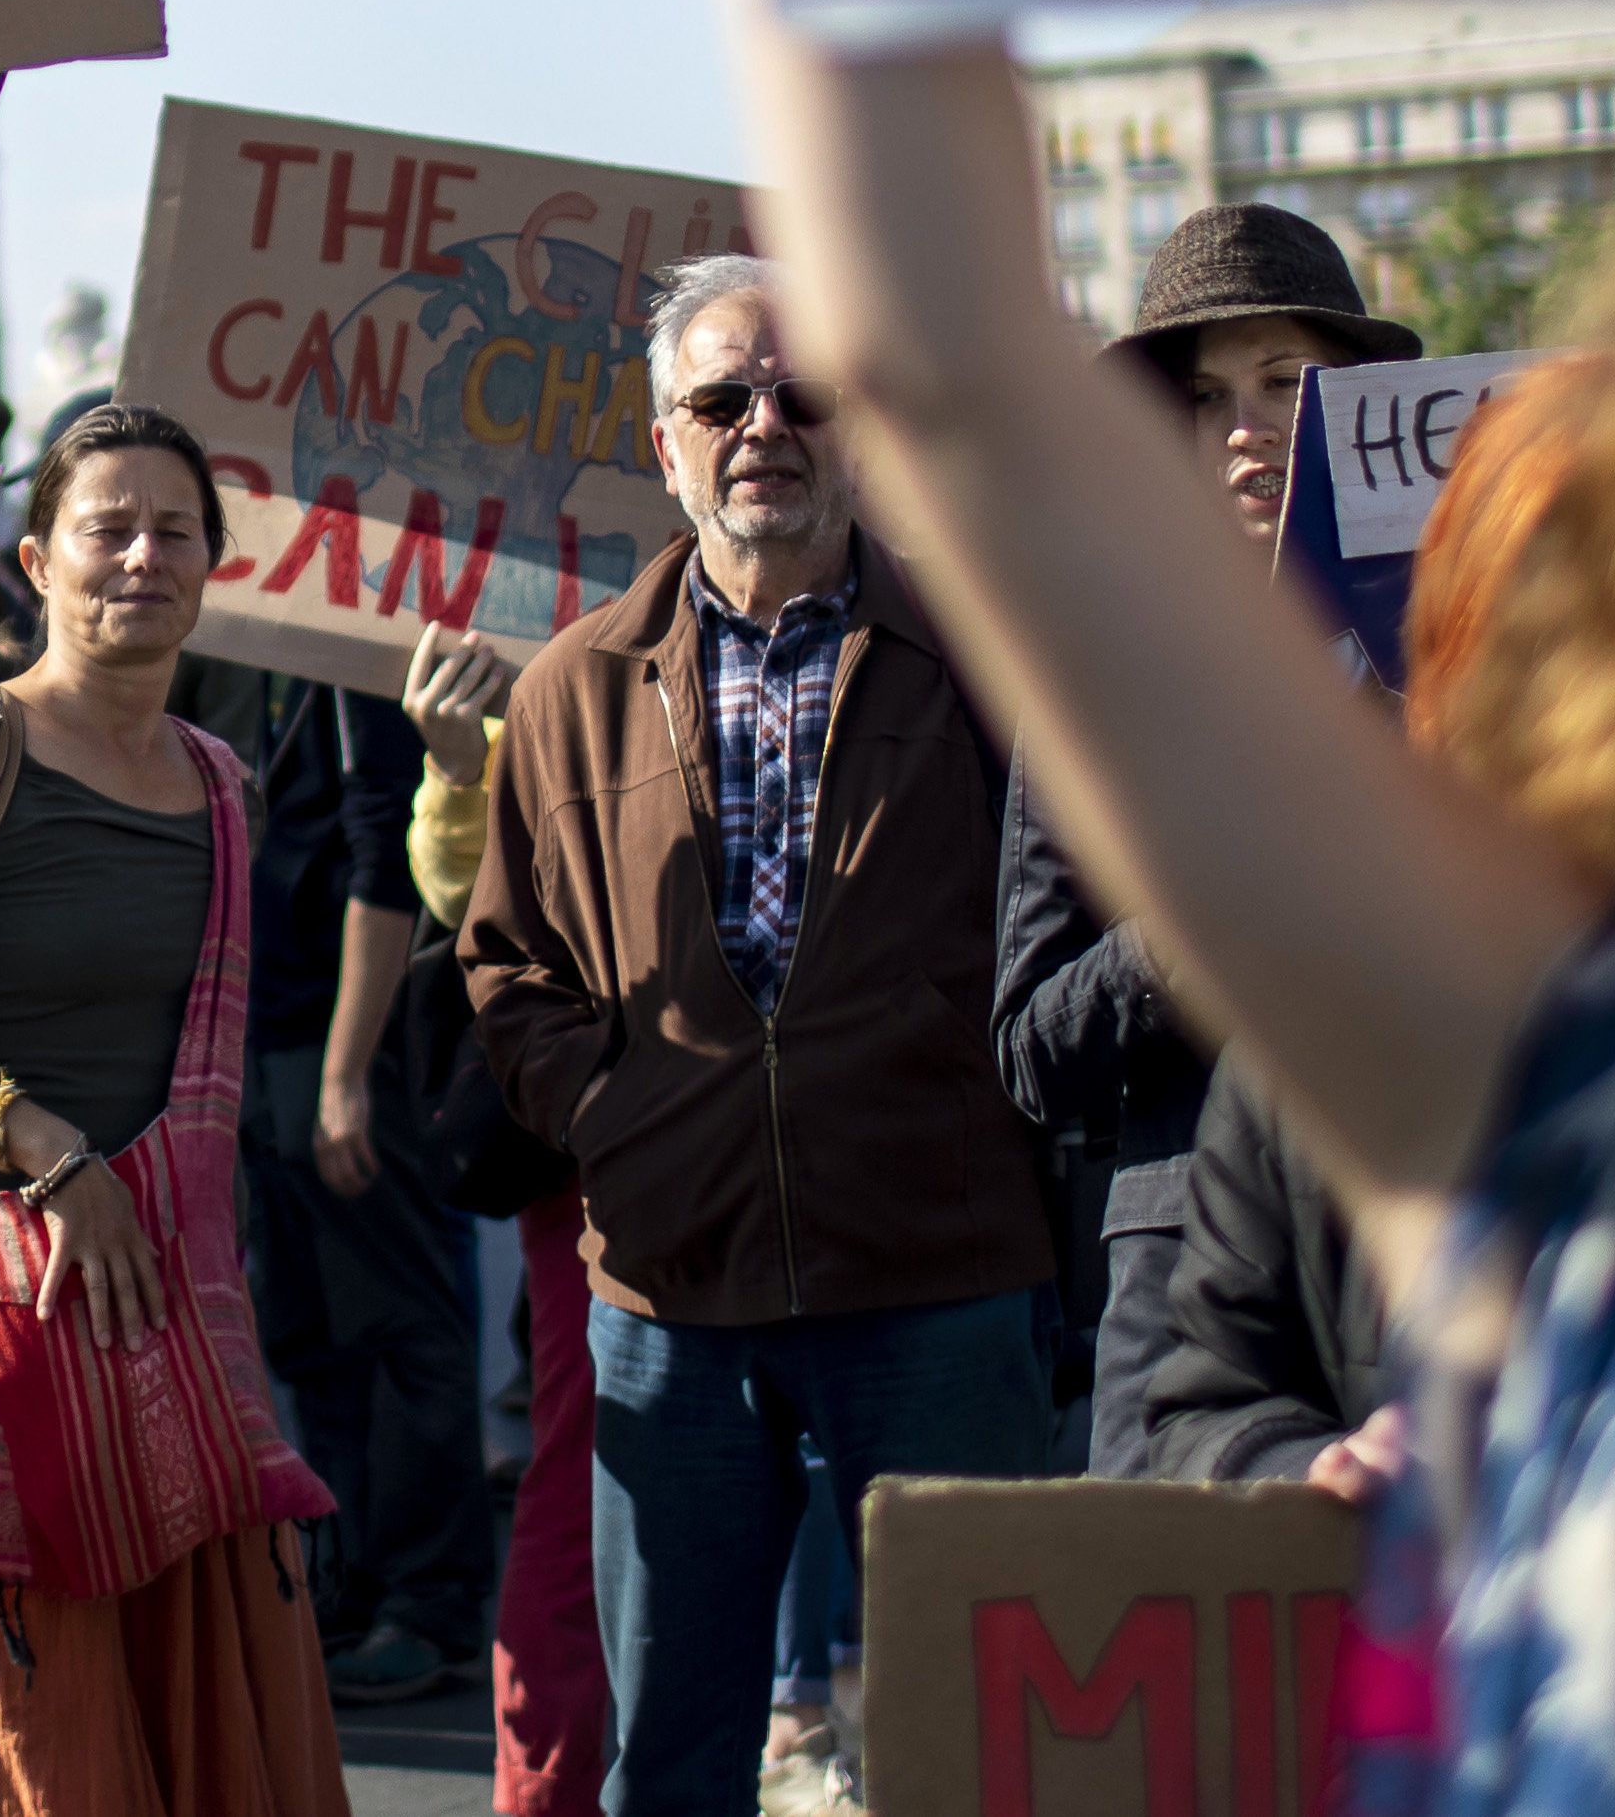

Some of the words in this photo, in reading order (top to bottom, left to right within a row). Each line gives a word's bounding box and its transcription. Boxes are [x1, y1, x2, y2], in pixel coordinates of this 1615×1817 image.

[238, 141, 477, 278] THE
[206, 298, 411, 425] CAN
[1351, 386, 1490, 491] HE
